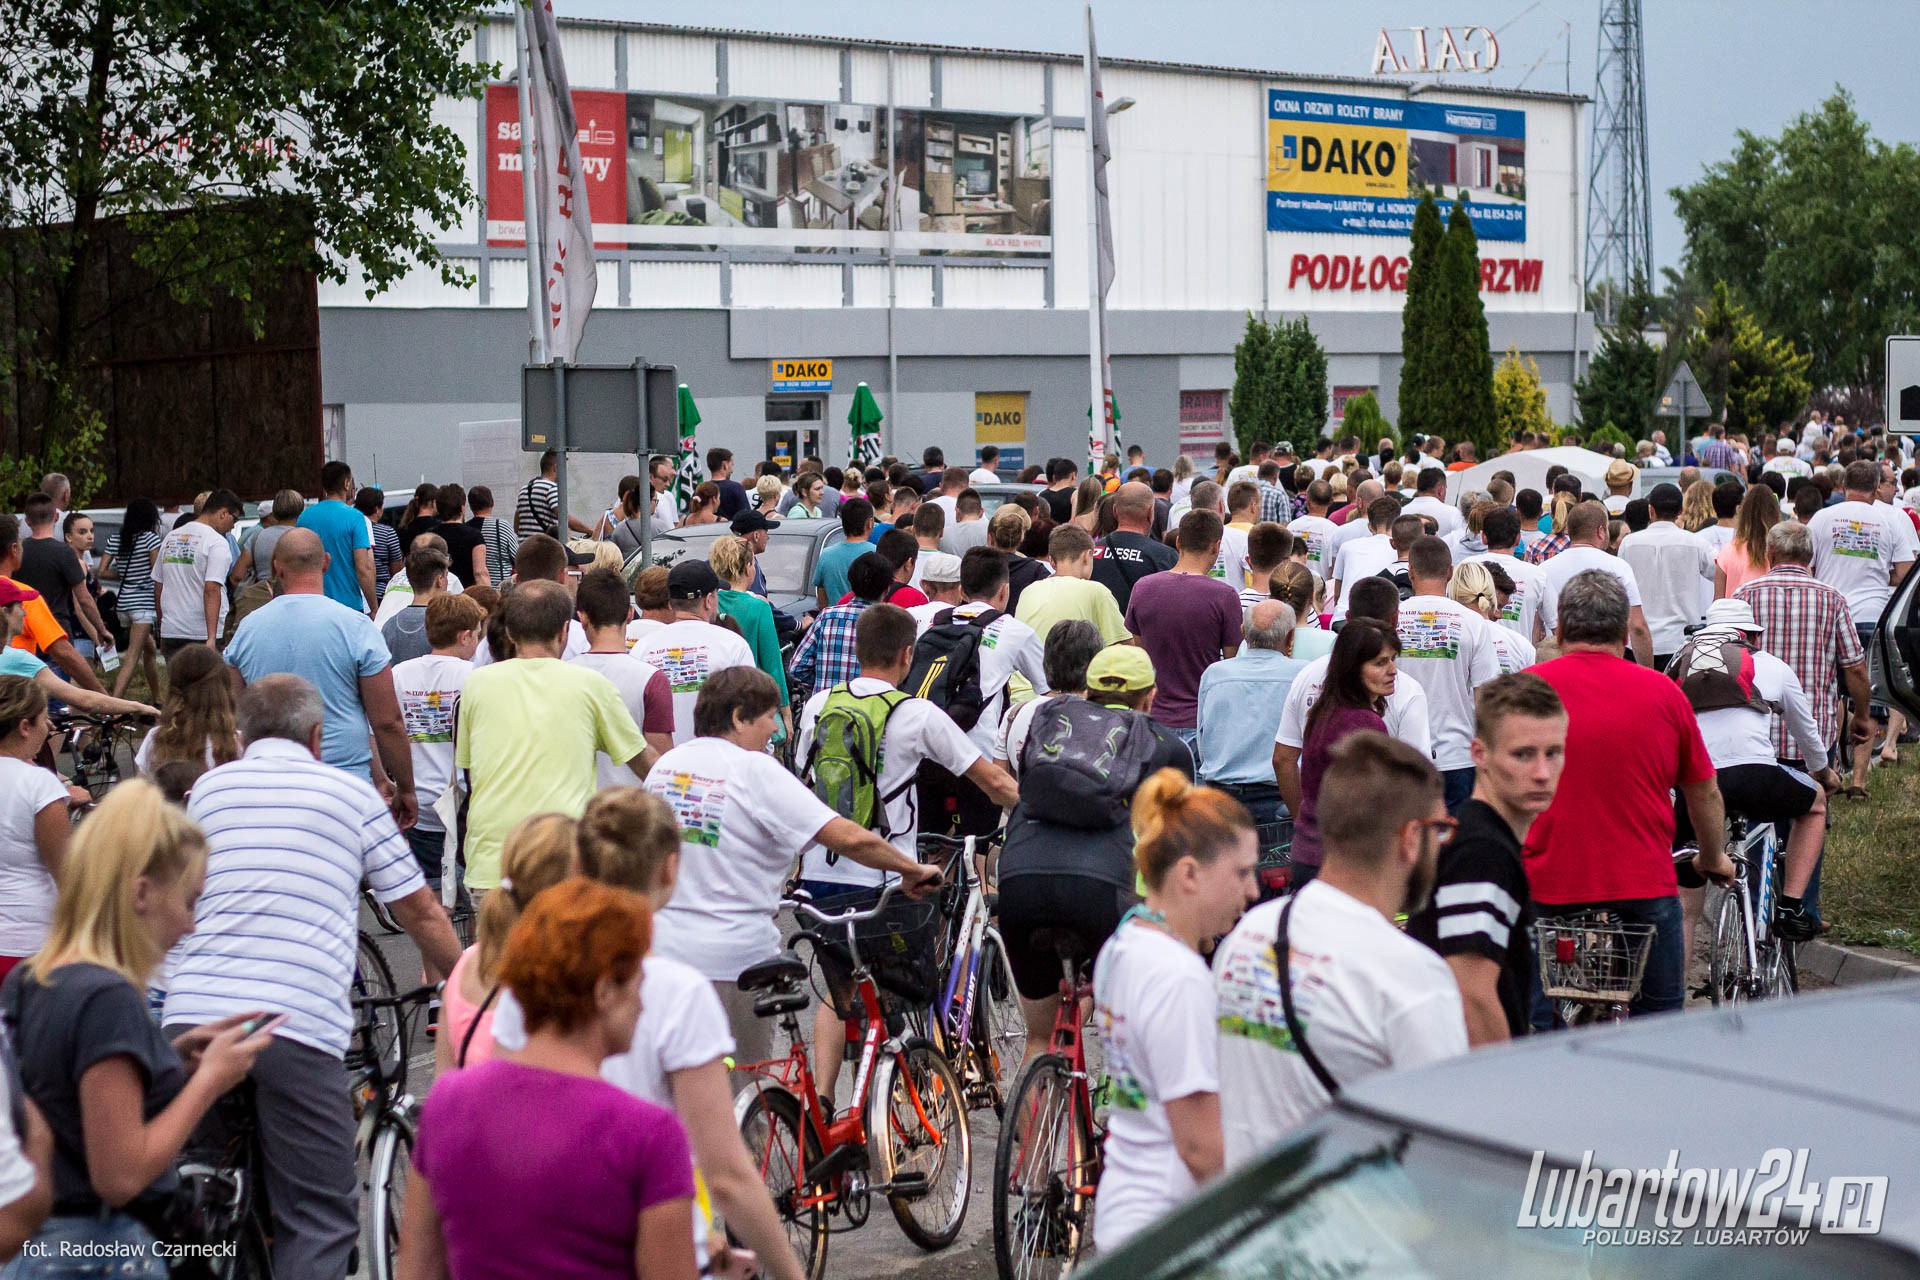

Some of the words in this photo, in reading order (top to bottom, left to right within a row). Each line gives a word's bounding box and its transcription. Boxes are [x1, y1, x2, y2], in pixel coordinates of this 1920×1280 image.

[1274, 99, 1300, 114] OKNA
[1304, 102, 1333, 116] DRZWI
[1338, 104, 1370, 119] ROLETY
[1373, 106, 1403, 121] BRAMY
[1301, 136, 1396, 177] DAKO
[1276, 198, 1300, 209] Partner
[1334, 198, 1374, 212] LUBARTÓW
[1289, 254, 1409, 291] PODŁOG
[1479, 258, 1543, 292] RZWI
[785, 364, 827, 377] DAKO
[984, 411, 1021, 426] DAKO
[1104, 547, 1143, 562] DESEL
[966, 971, 976, 1016] GIANT
